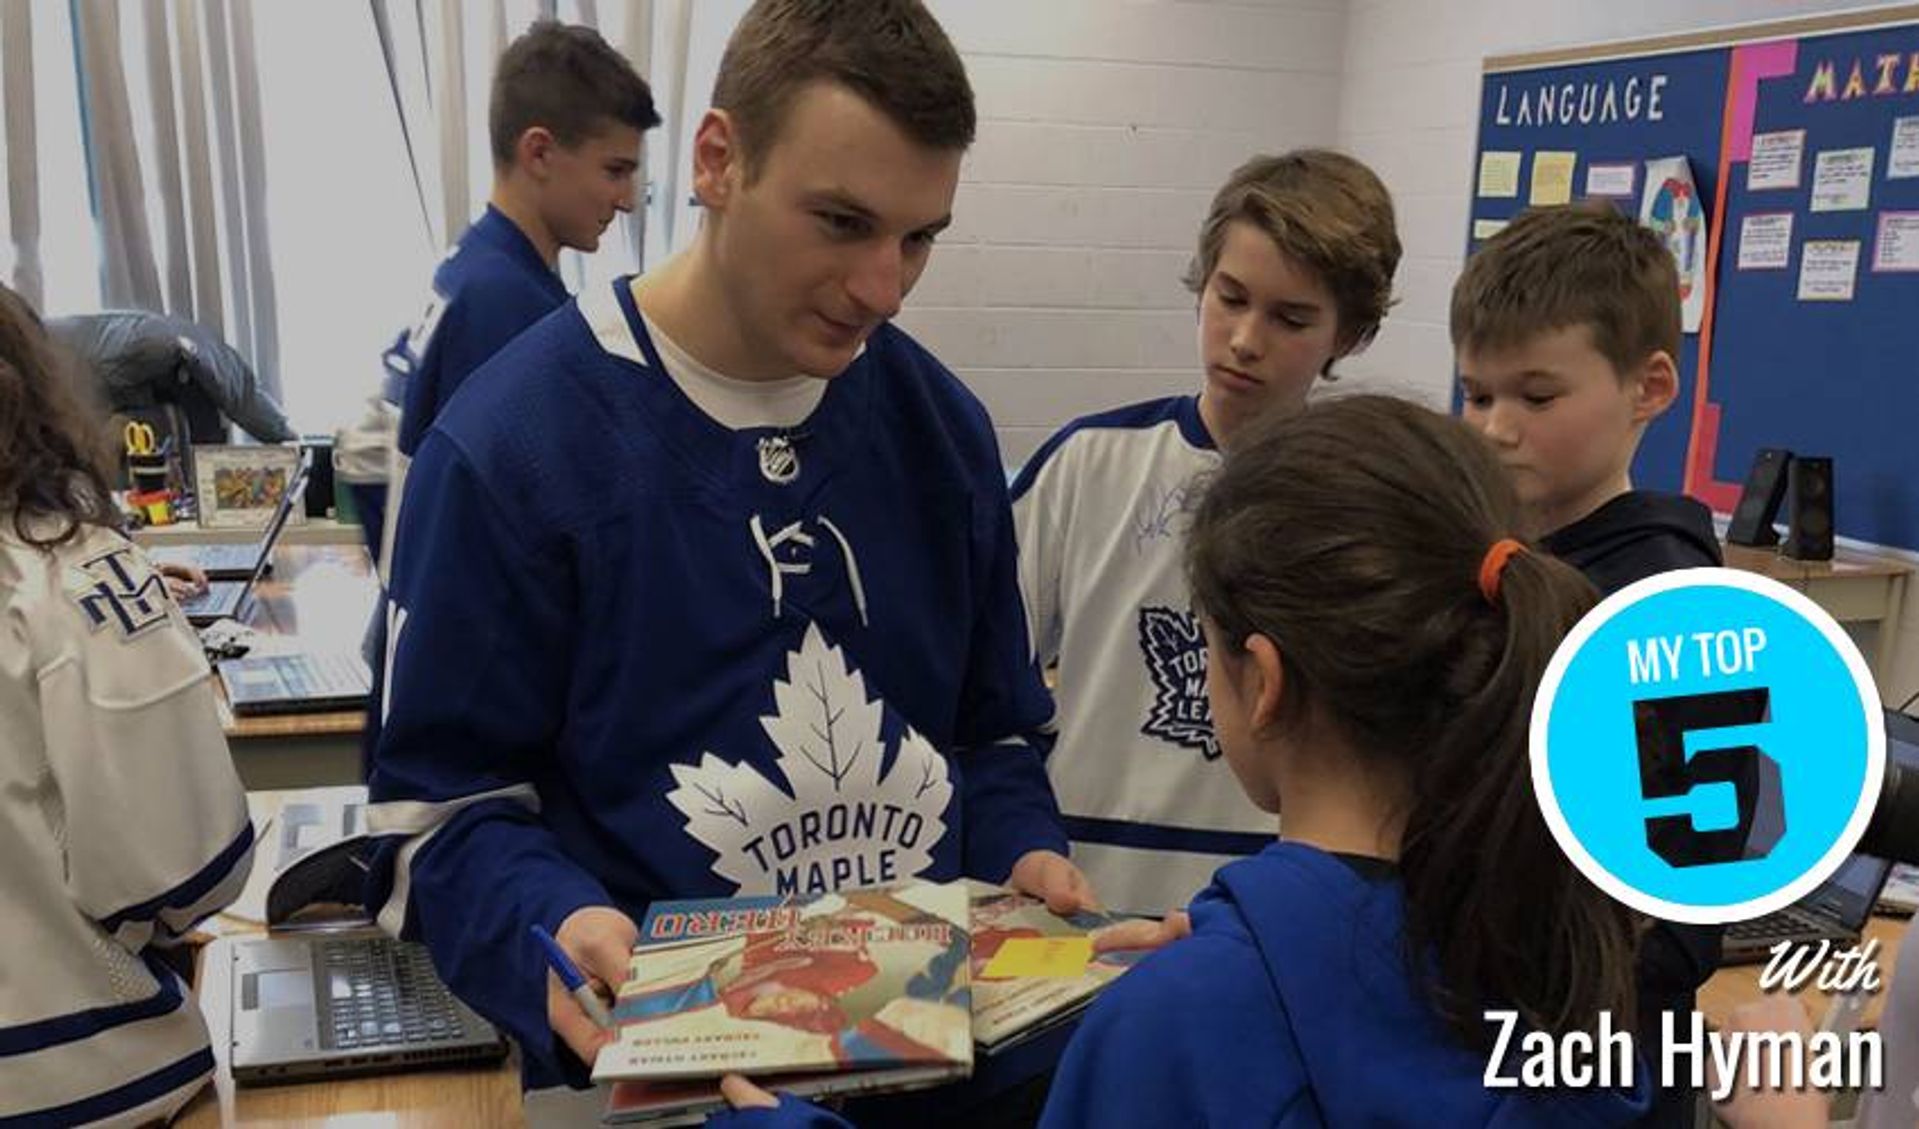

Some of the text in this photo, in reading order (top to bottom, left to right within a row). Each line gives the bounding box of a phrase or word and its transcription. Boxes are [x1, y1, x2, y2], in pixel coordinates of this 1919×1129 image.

[1496, 75, 1669, 127] LANGUAGE
[742, 803, 924, 873] TORONTO
[775, 848, 897, 897] MAPLE
